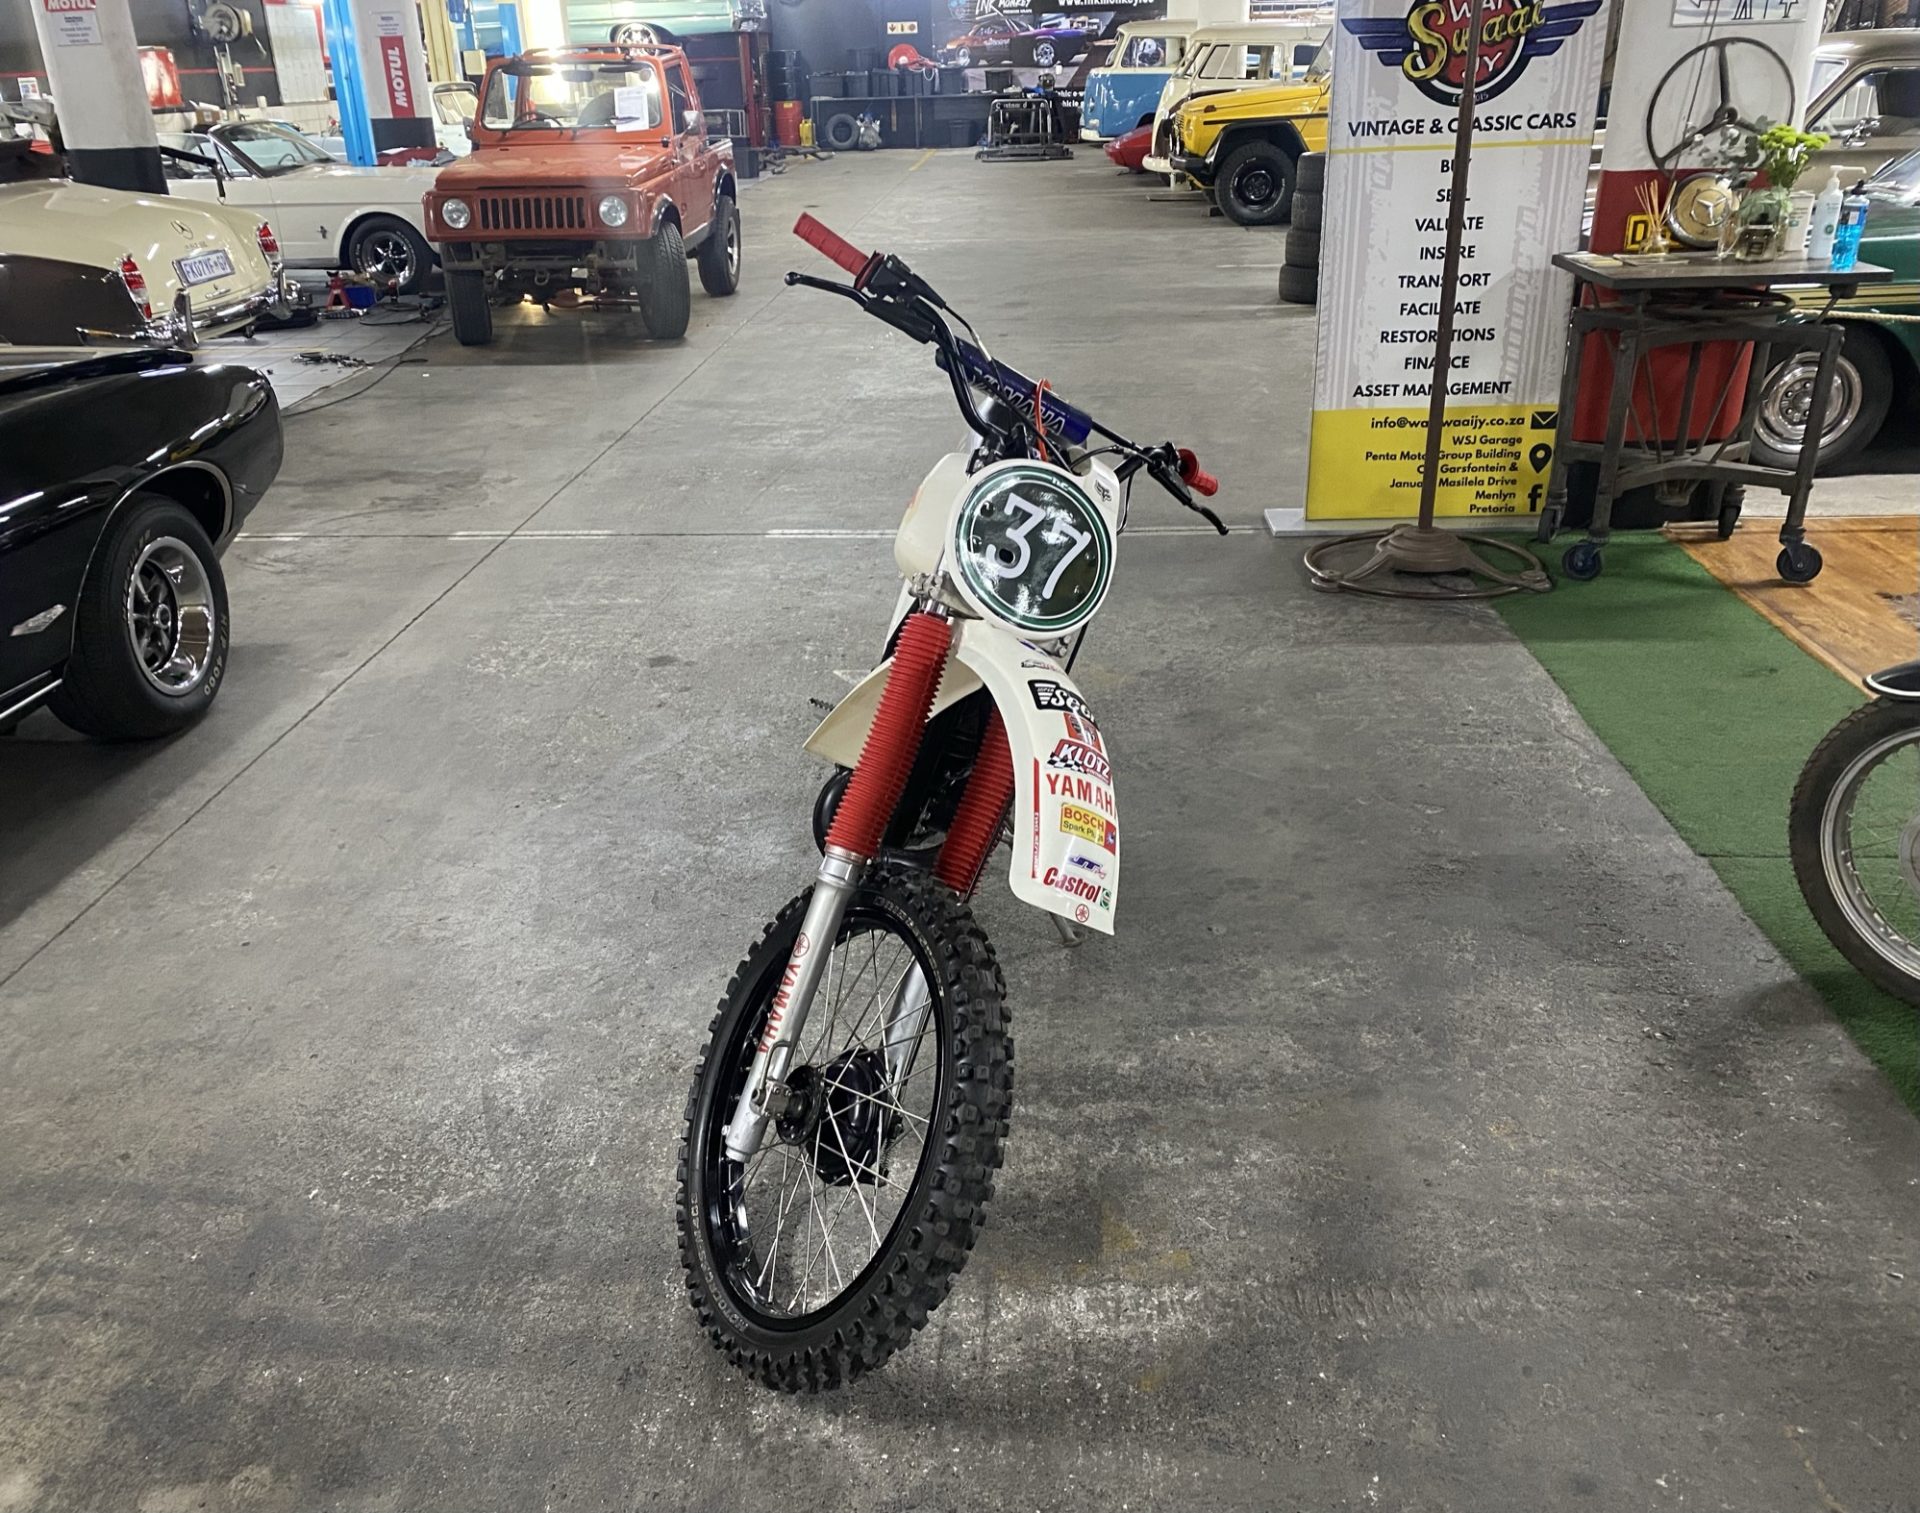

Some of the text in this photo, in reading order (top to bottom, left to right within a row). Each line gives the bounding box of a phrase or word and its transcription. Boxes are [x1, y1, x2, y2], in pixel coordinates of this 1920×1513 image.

[48, 0, 96, 10] MOTUL
[387, 46, 408, 107] MOTUL
[1348, 112, 1577, 137] VINTAGE & CASSIC CARS
[1420, 245, 1476, 260] INSRE
[1400, 301, 1481, 316] FACILATE
[1380, 328, 1495, 344] RESTORTIONS
[1352, 384, 1400, 398] ASSET
[1452, 435, 1522, 448] WSJ Garage
[1365, 451, 1397, 461] Penta
[1438, 450, 1473, 461] Group
[1475, 448, 1521, 461] Building
[1440, 463, 1519, 474] Garsfontein &
[1438, 477, 1485, 488] Masilela
[1487, 477, 1517, 487] Drive
[1475, 490, 1516, 501] Menlyn
[1469, 503, 1515, 514] Pretoria
[986, 492, 1092, 600] 37
[1059, 743, 1111, 779] KLOTZ
[1064, 807, 1104, 832] BOSCH
[1043, 867, 1101, 903] Castrol
[757, 963, 801, 1053] YAMAHA
